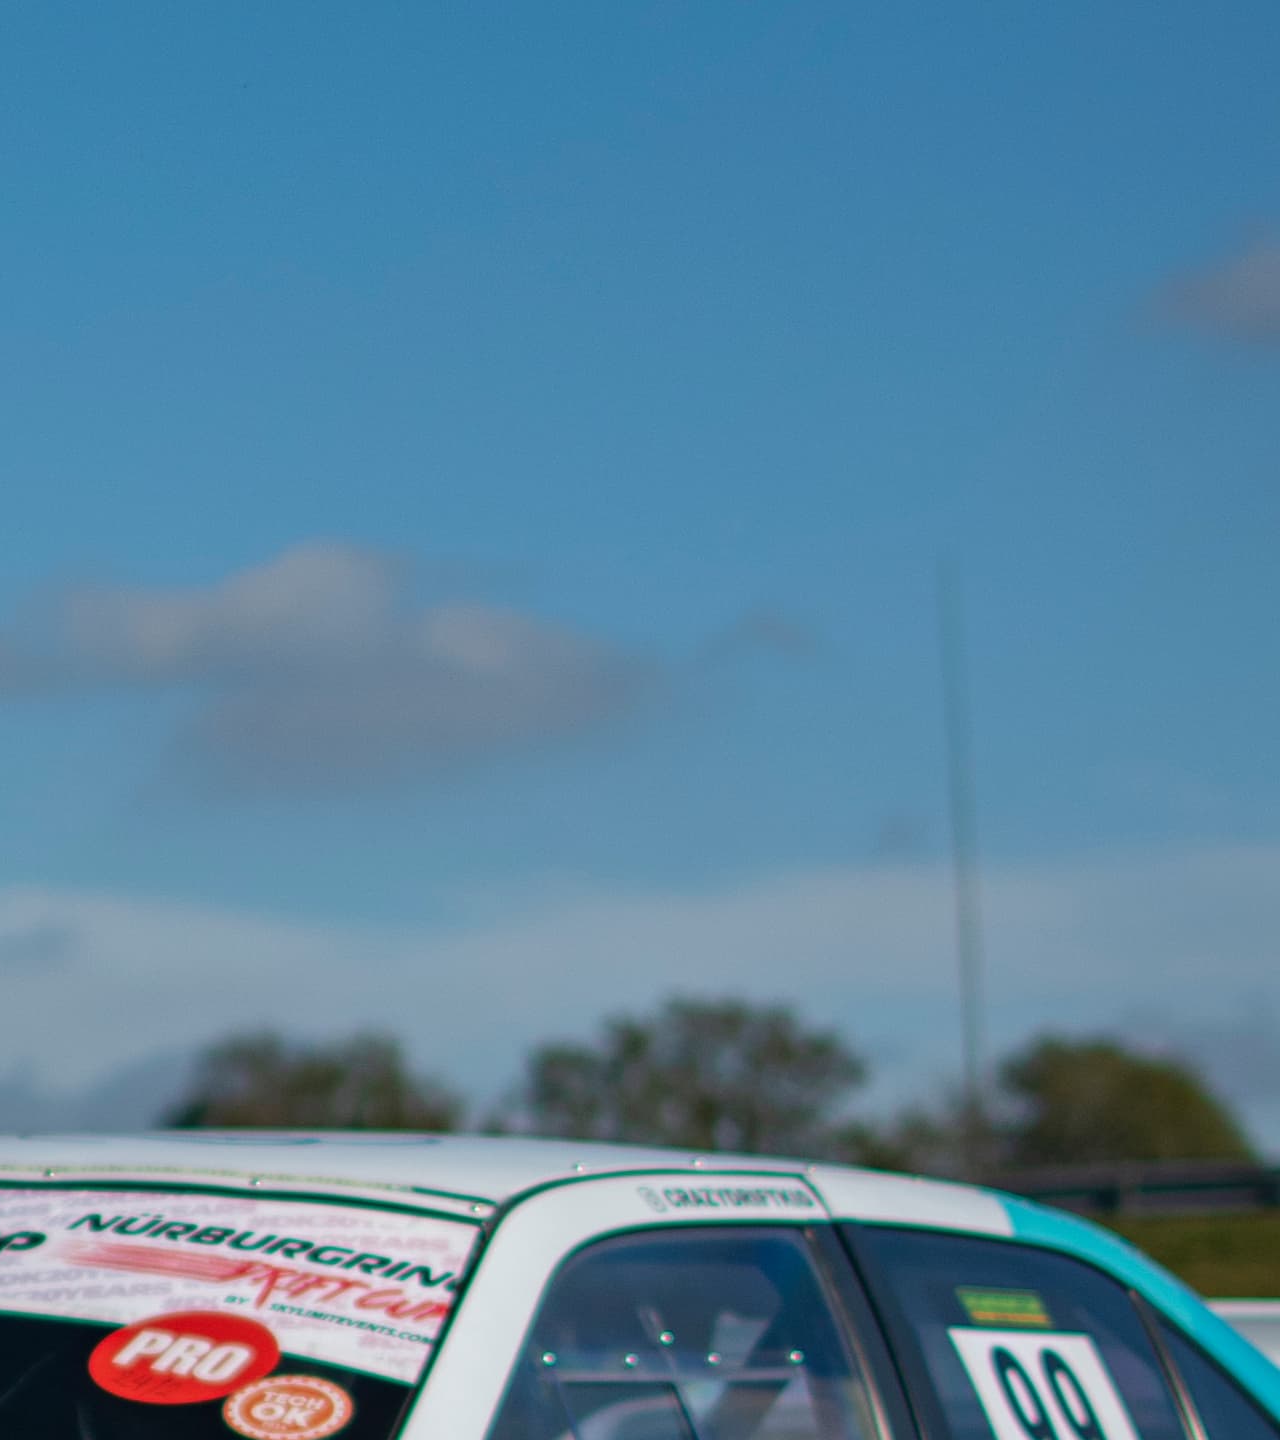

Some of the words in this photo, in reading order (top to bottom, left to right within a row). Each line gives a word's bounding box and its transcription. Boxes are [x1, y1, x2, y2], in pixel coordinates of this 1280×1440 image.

[111, 1329, 253, 1385] PRO
[263, 1391, 326, 1410] TECH
[250, 1403, 316, 1428] OK
